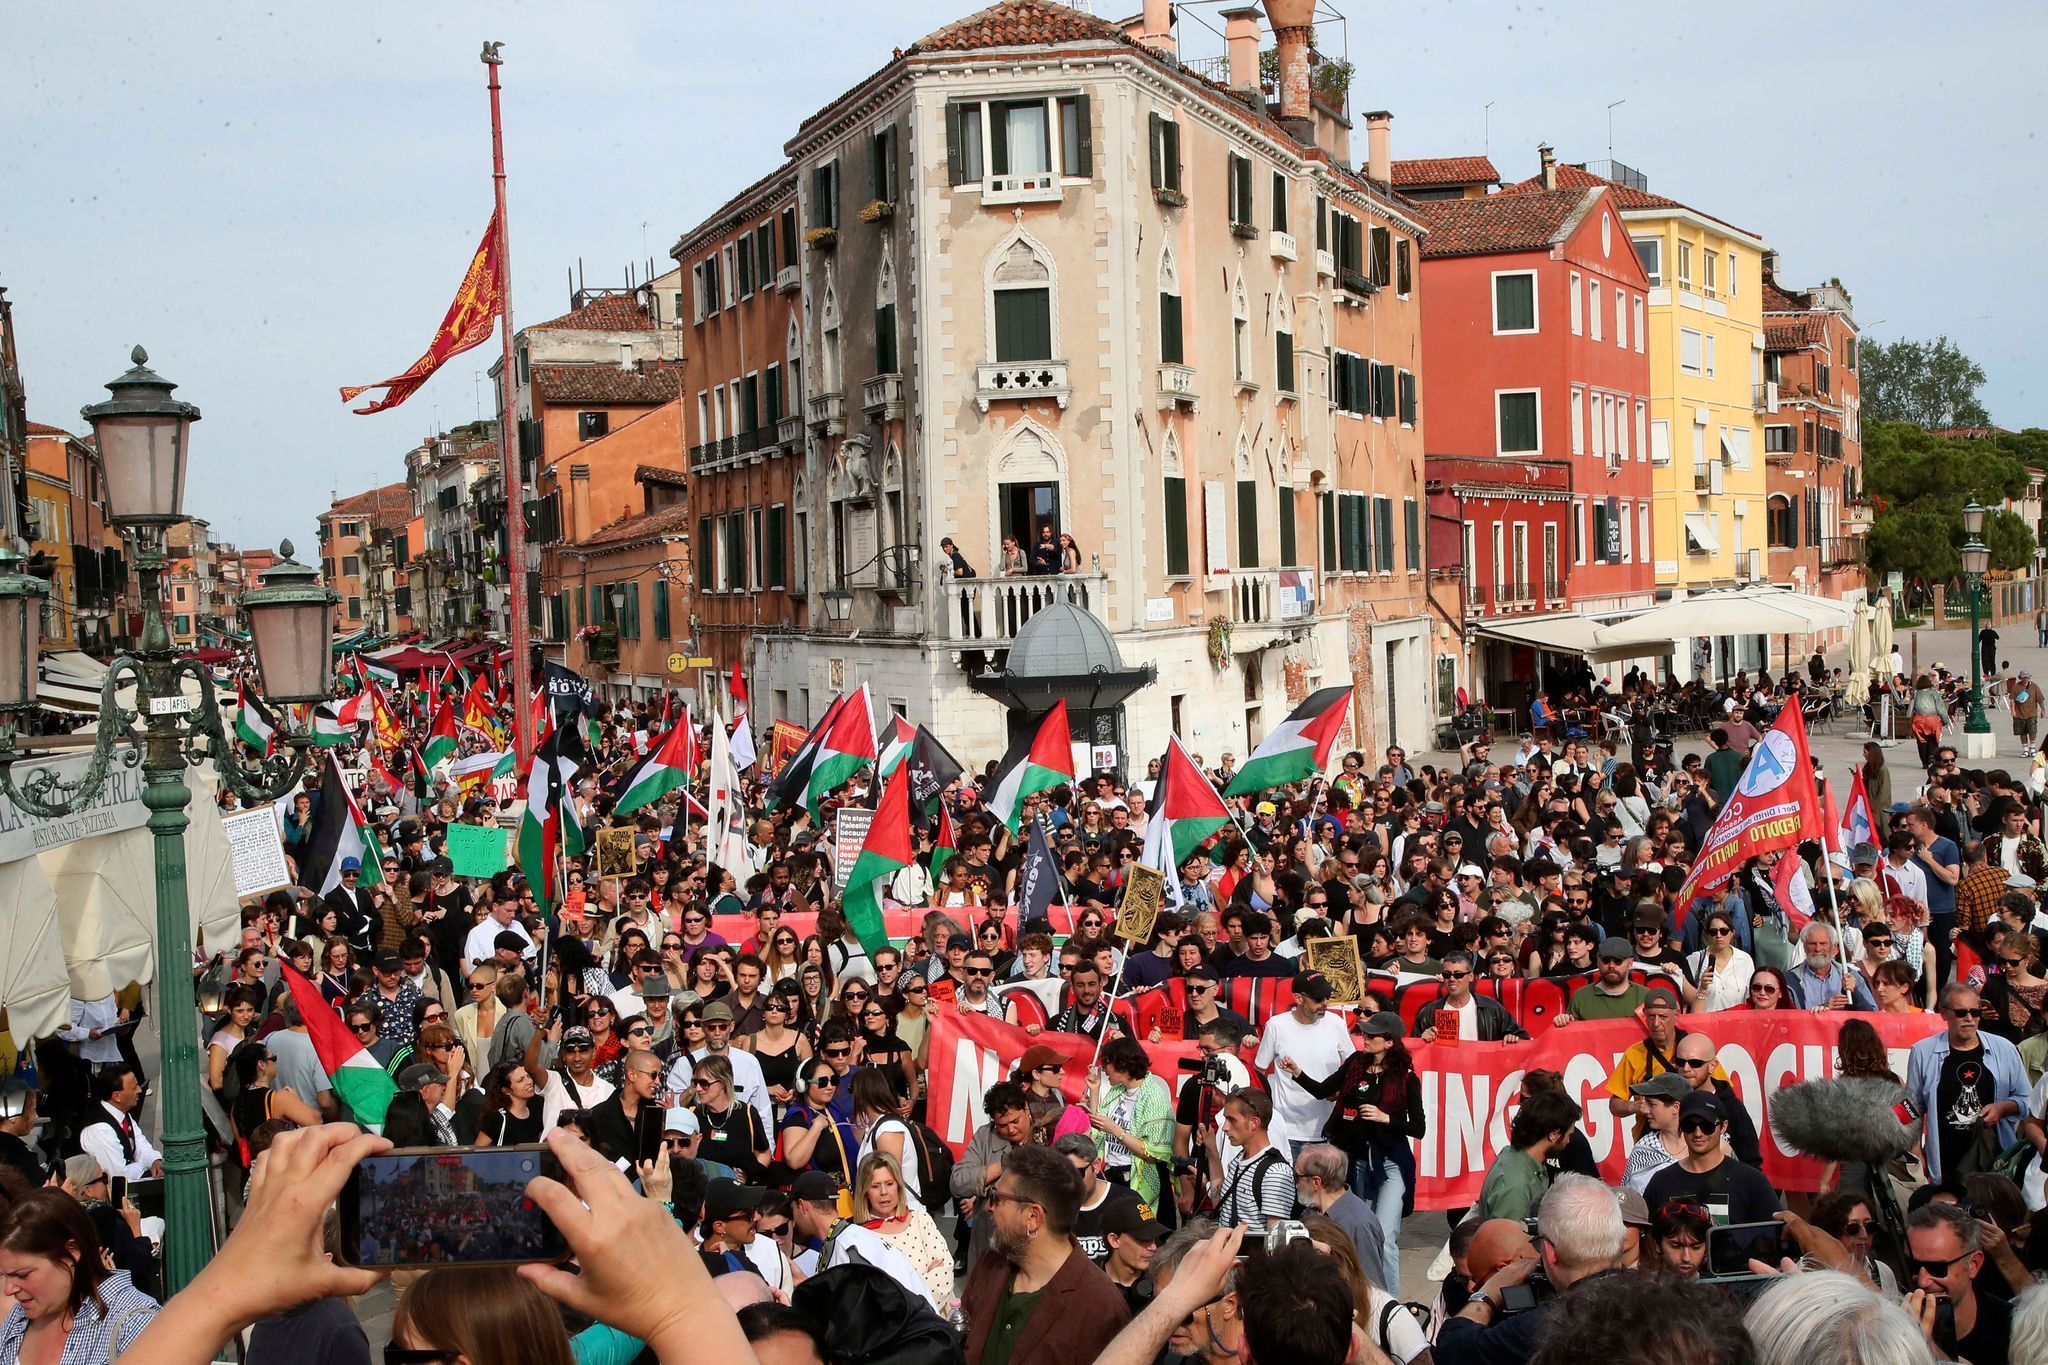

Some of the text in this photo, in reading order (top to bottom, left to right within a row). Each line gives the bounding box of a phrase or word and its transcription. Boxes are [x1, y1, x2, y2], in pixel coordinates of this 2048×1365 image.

[669, 658, 683, 668] PT
[156, 699, 187, 711] CS AF15
[841, 814, 851, 822] We
[32, 810, 119, 849] RISTORANTE PIZZERIA
[1161, 1008, 1178, 1016] SHUT
